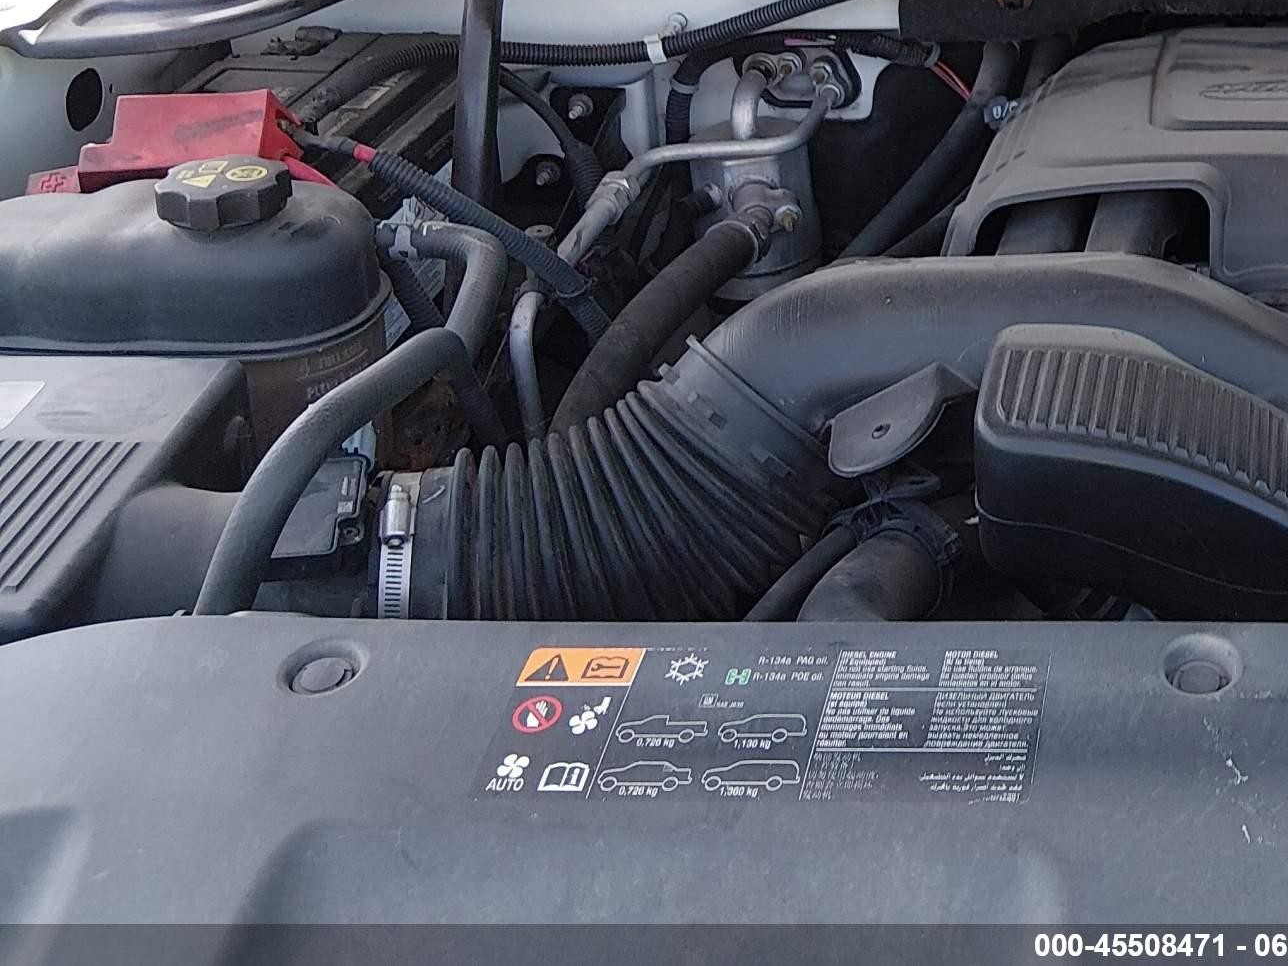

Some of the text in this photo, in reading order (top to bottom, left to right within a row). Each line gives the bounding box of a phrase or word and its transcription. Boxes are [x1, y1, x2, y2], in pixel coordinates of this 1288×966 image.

[662, 737, 676, 749] kg
[759, 738, 772, 750] kg
[486, 778, 524, 792] AUTO
[644, 786, 659, 798] kg
[745, 787, 759, 799] kg
